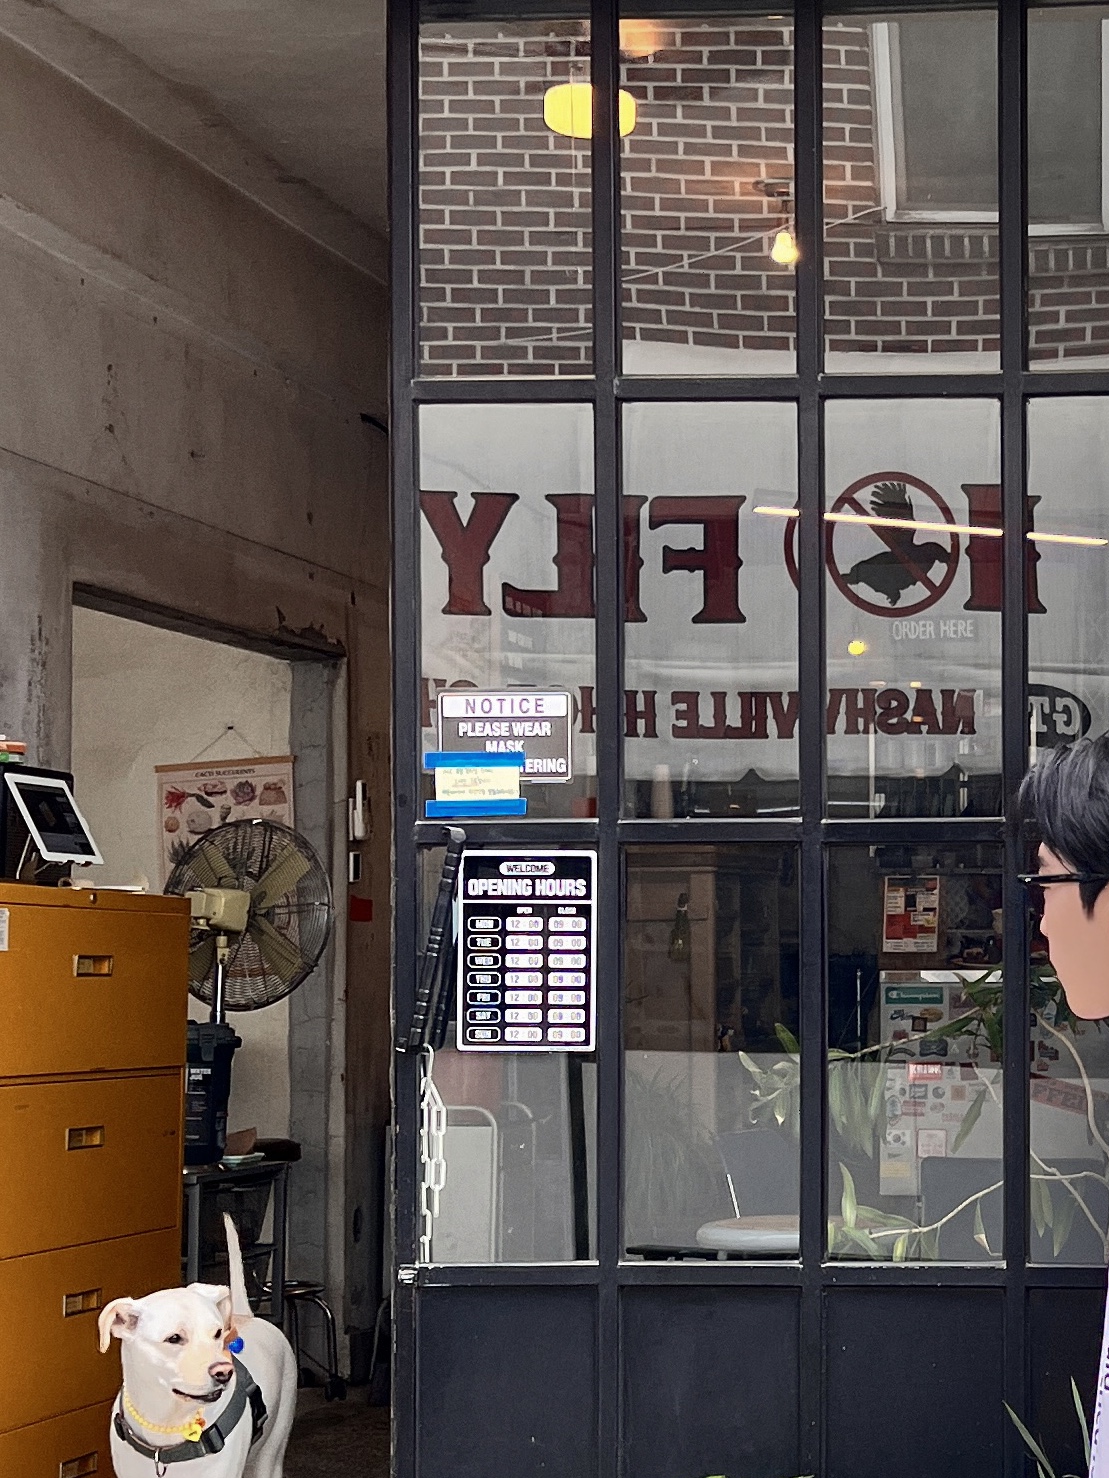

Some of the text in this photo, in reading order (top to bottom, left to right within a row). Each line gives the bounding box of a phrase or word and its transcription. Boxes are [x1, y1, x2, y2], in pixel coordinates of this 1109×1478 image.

[893, 620, 974, 640] ORDER HERE
[465, 698, 545, 715] NOTICE
[458, 721, 552, 737] PLEASE WEAR
[485, 740, 525, 752] MASK
[520, 757, 567, 773] ERING
[506, 864, 549, 873] WELCOME
[467, 878, 587, 896] OPENING HOURS
